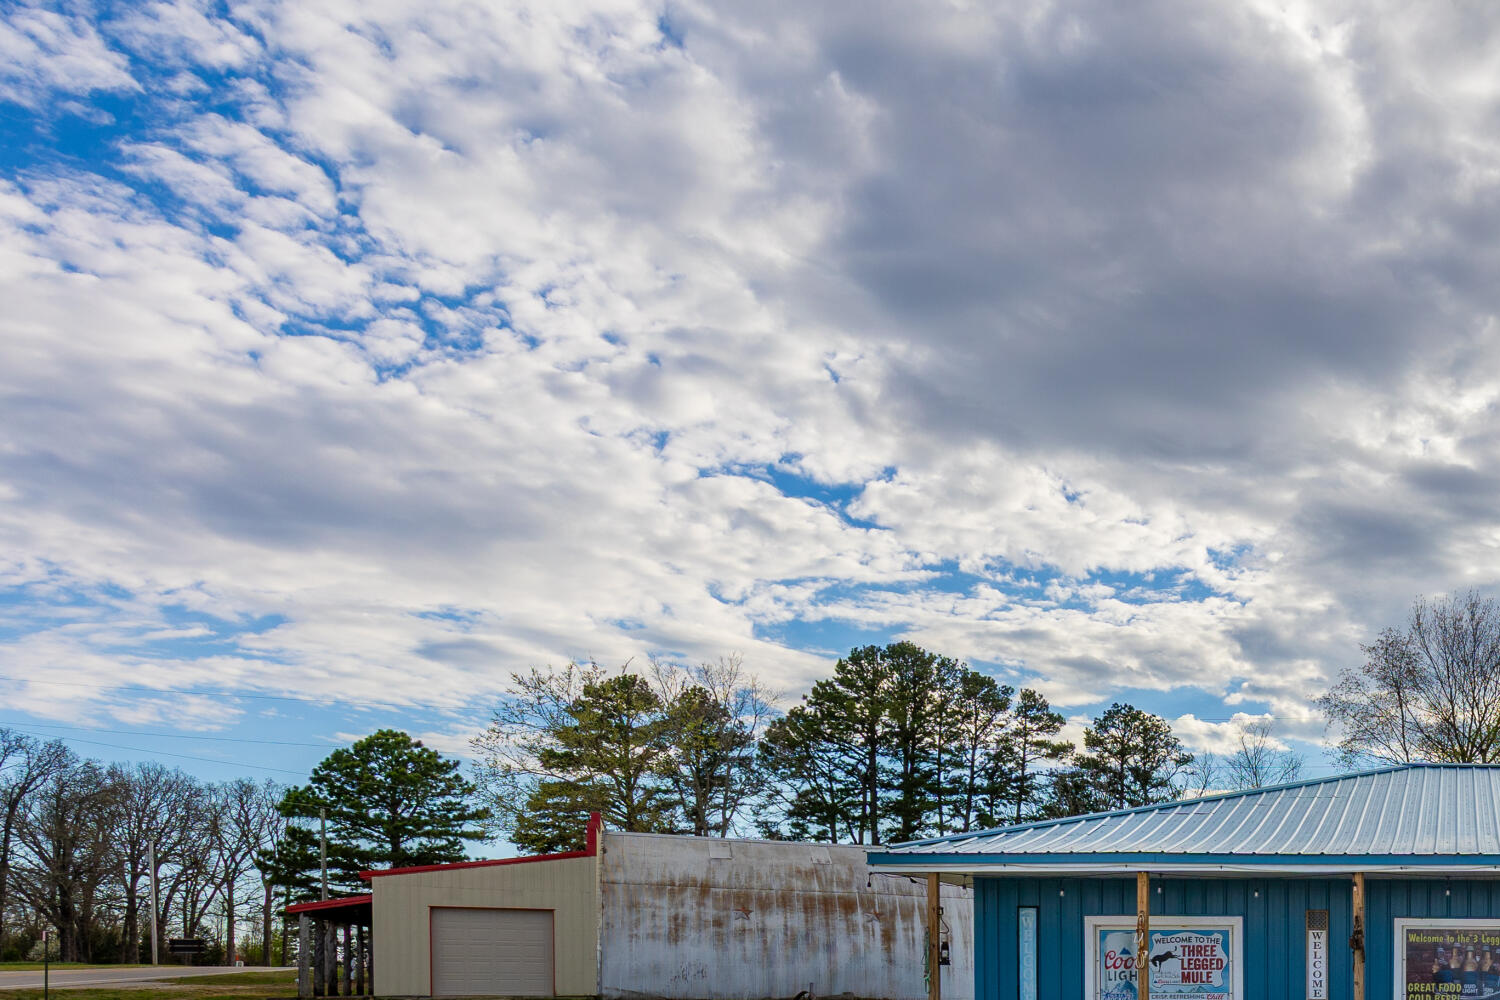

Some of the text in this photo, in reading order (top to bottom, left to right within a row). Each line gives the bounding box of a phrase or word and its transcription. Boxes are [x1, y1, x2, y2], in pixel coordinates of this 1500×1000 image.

[1154, 936, 1193, 945] WELCOME
[1206, 937, 1221, 945] THE
[1408, 932, 1444, 943] Welcome
[1447, 934, 1455, 943] to
[1457, 933, 1471, 943] the
[1473, 934, 1479, 943] 3
[1181, 945, 1217, 958] THREE
[1181, 958, 1224, 971] LEGGED
[1312, 931, 1323, 998] WELCOME
[1108, 970, 1138, 981] LIGH
[1181, 971, 1213, 984] MULE
[1408, 982, 1462, 993] GREAT FOOD
